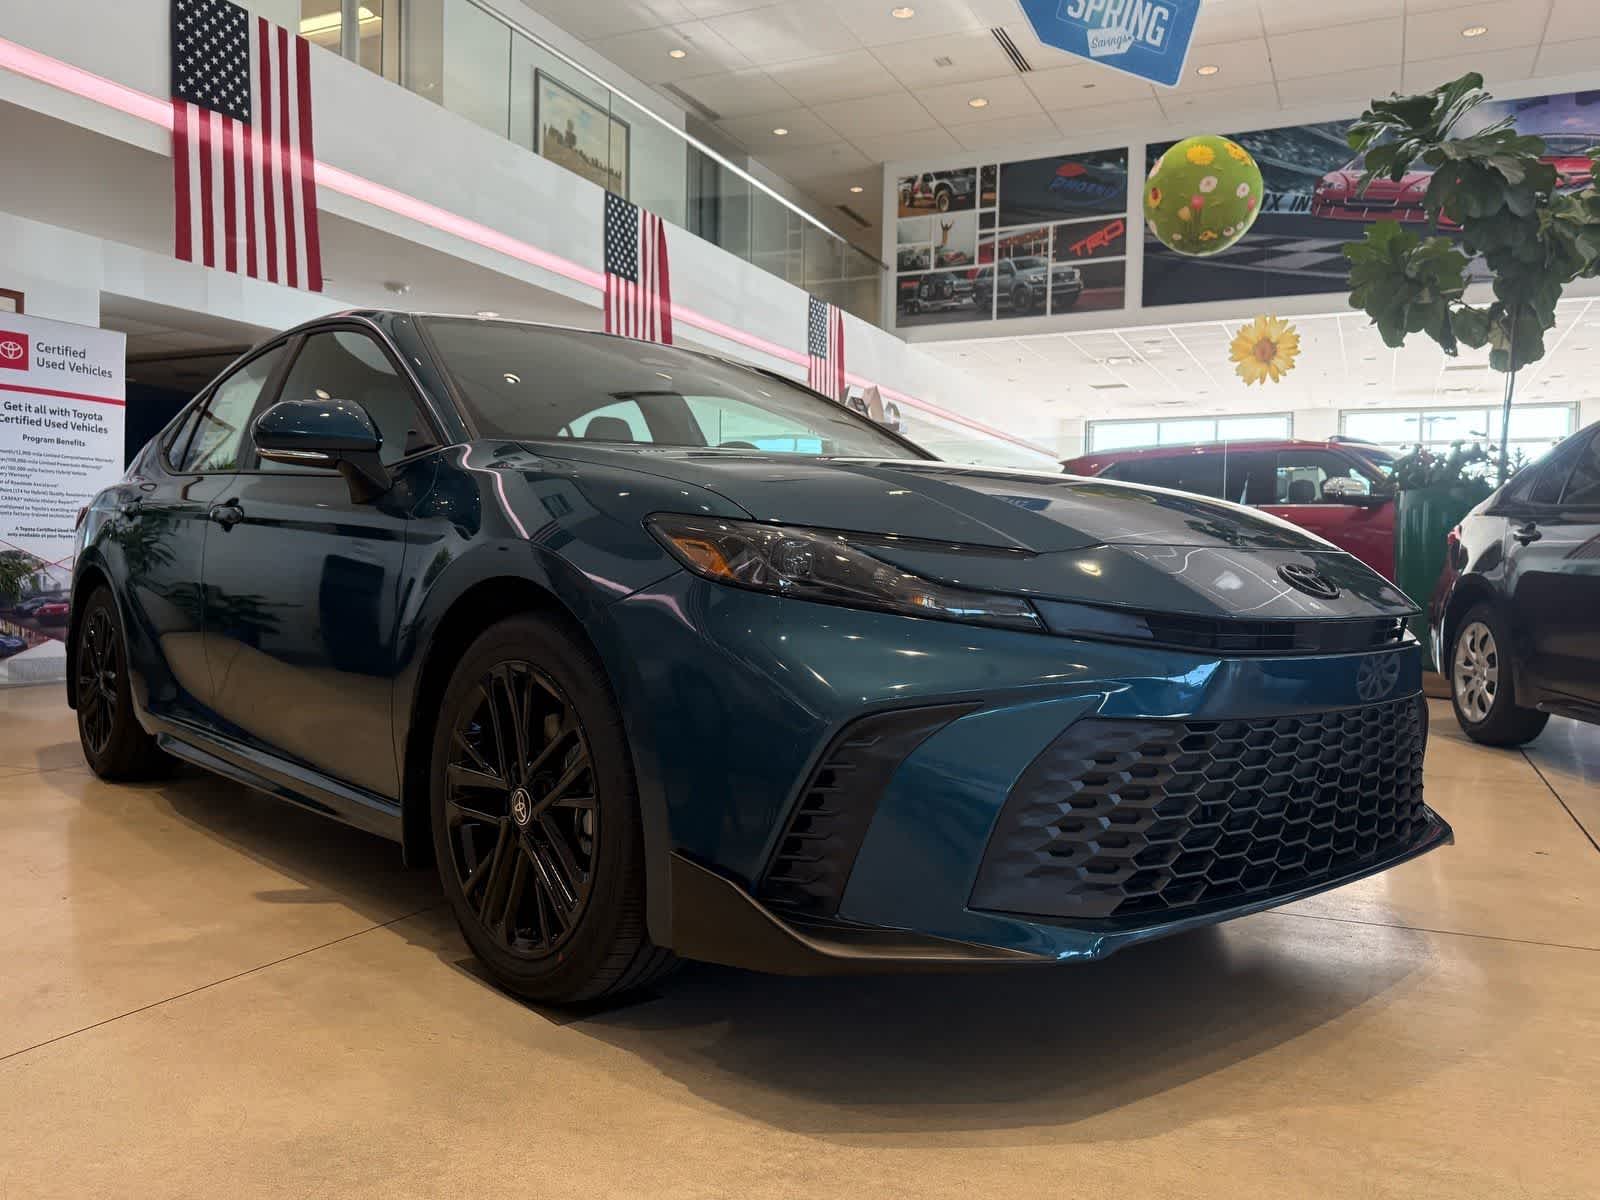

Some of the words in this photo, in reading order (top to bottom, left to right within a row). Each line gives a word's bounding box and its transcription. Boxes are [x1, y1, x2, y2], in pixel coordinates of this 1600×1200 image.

[1090, 34, 1130, 49] Savings
[1068, 219, 1124, 256] TRD
[36, 342, 86, 359] Certified
[36, 357, 65, 371] Used
[68, 361, 113, 378] Vehicles
[3, 401, 23, 411] Get
[24, 403, 33, 412] it
[34, 405, 46, 415] all
[49, 406, 70, 417] with
[72, 409, 103, 421] Toyota
[0, 413, 42, 427] Certified
[44, 419, 68, 430] Used
[70, 422, 108, 434] Vehicles
[22, 434, 55, 444] Program
[56, 438, 86, 448] Benefits
